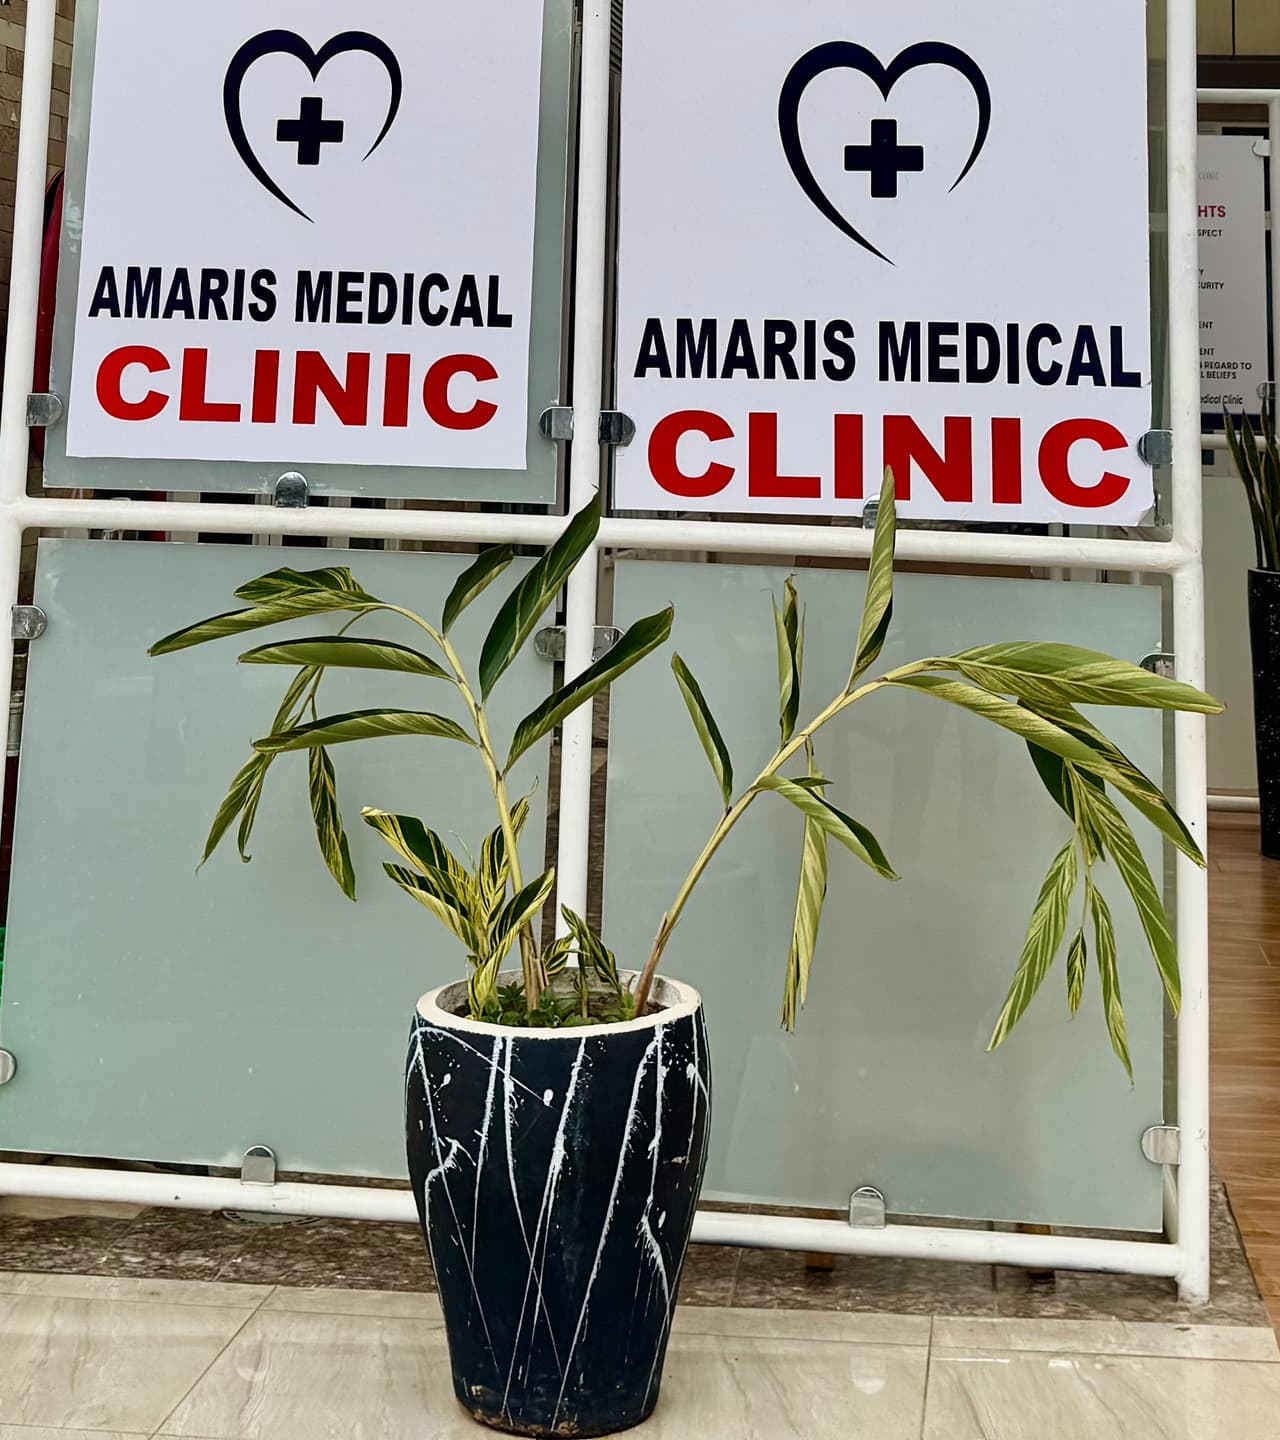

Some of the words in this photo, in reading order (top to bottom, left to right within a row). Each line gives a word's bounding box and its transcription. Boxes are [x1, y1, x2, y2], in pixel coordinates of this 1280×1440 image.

[88, 265, 277, 323] AMARIS
[294, 270, 513, 328] MEDICAL
[634, 317, 856, 380] AMARIS
[879, 321, 1142, 388] MEDICAL
[1204, 361, 1238, 370] REGARD
[1241, 362, 1252, 370] TO
[1206, 371, 1237, 379] BELIEFS
[95, 344, 499, 430] CLINIC
[647, 409, 1132, 508] CLINIC
